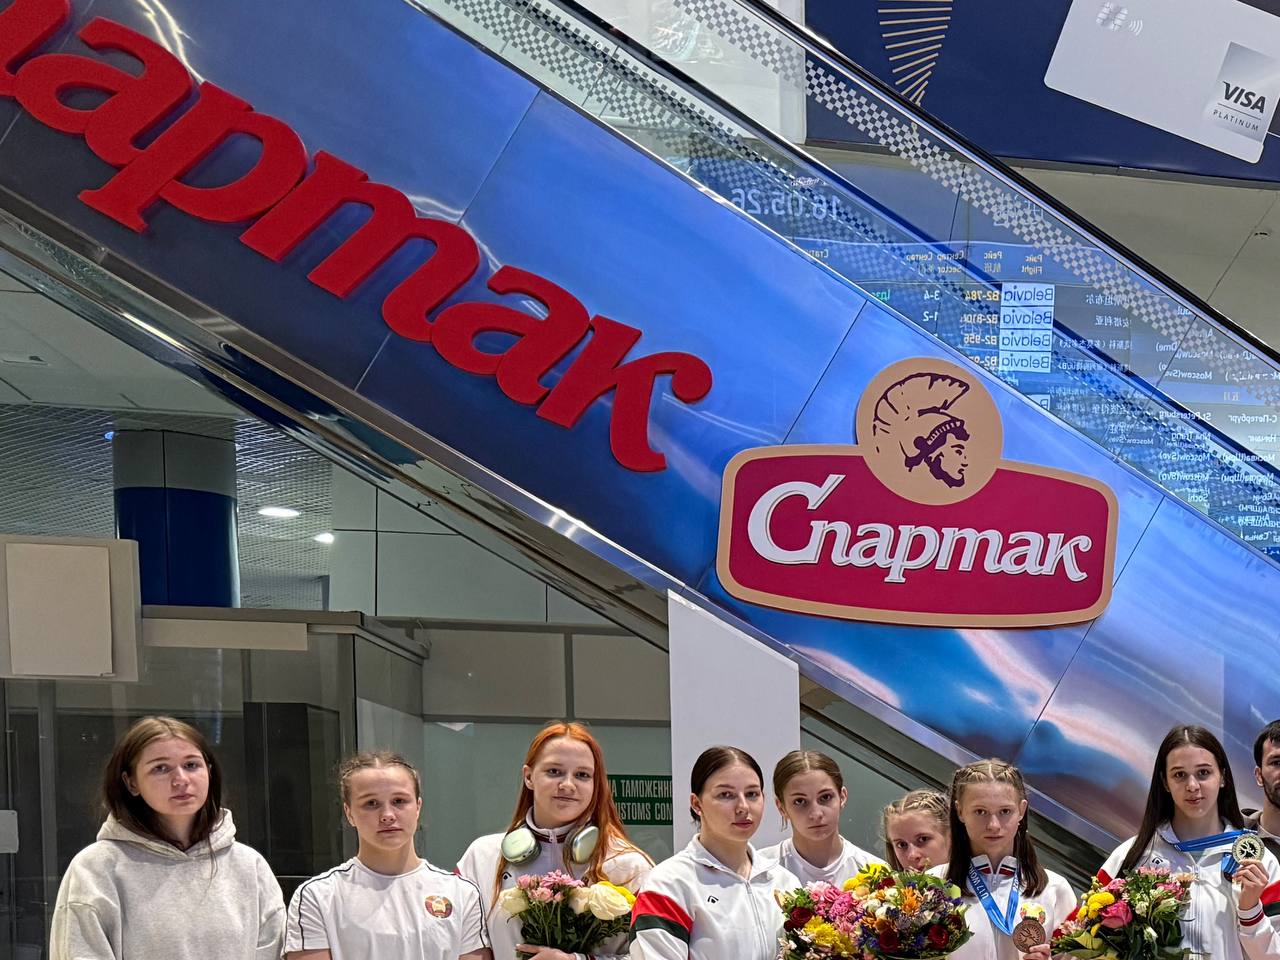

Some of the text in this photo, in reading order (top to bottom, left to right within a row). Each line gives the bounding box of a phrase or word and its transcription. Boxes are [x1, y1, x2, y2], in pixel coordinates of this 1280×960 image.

[1222, 80, 1266, 114] VISA
[1212, 108, 1259, 132] PLATINUM
[746, 474, 1093, 583] Спартак
[620, 779, 672, 798] ТАМОЖЕНН
[615, 802, 672, 821] USTOMS CON
